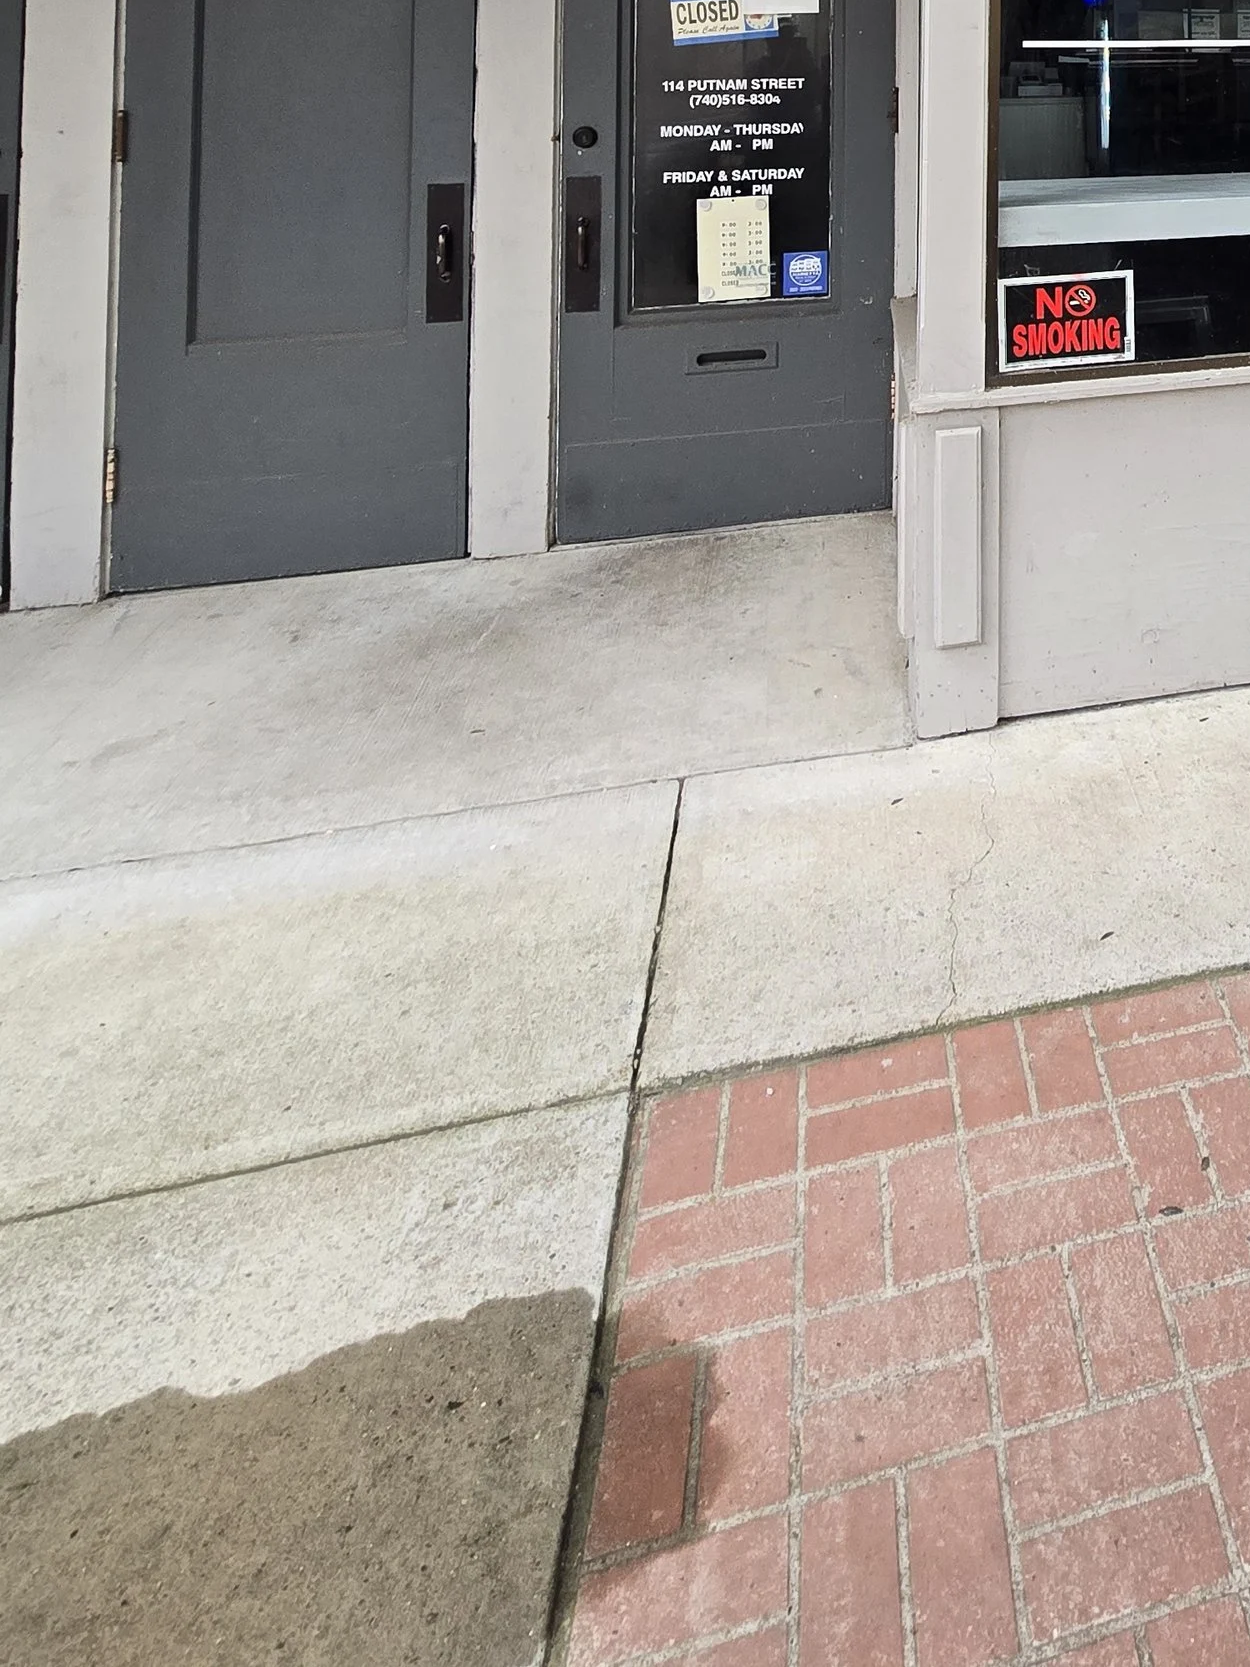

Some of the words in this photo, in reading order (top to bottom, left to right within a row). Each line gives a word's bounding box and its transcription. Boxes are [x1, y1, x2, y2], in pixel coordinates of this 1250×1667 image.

[676, 0, 739, 25] CLOSED
[677, 27, 700, 35] Please
[702, 25, 717, 34] Call
[718, 24, 740, 33] Again
[662, 80, 684, 92] 114
[687, 78, 747, 92] PUTNAM
[750, 77, 806, 90] STREET
[689, 93, 781, 109] (740)516-8304
[660, 124, 722, 138] MONDAY
[709, 139, 732, 152] AM
[752, 138, 774, 151] PM
[662, 170, 714, 184] FRIDAY
[717, 170, 728, 182] &
[731, 167, 805, 181] SATURDAY
[709, 185, 732, 198] AM
[752, 184, 773, 196] PM
[1036, 284, 1097, 320] NO
[1012, 316, 1121, 358] SMOKING
